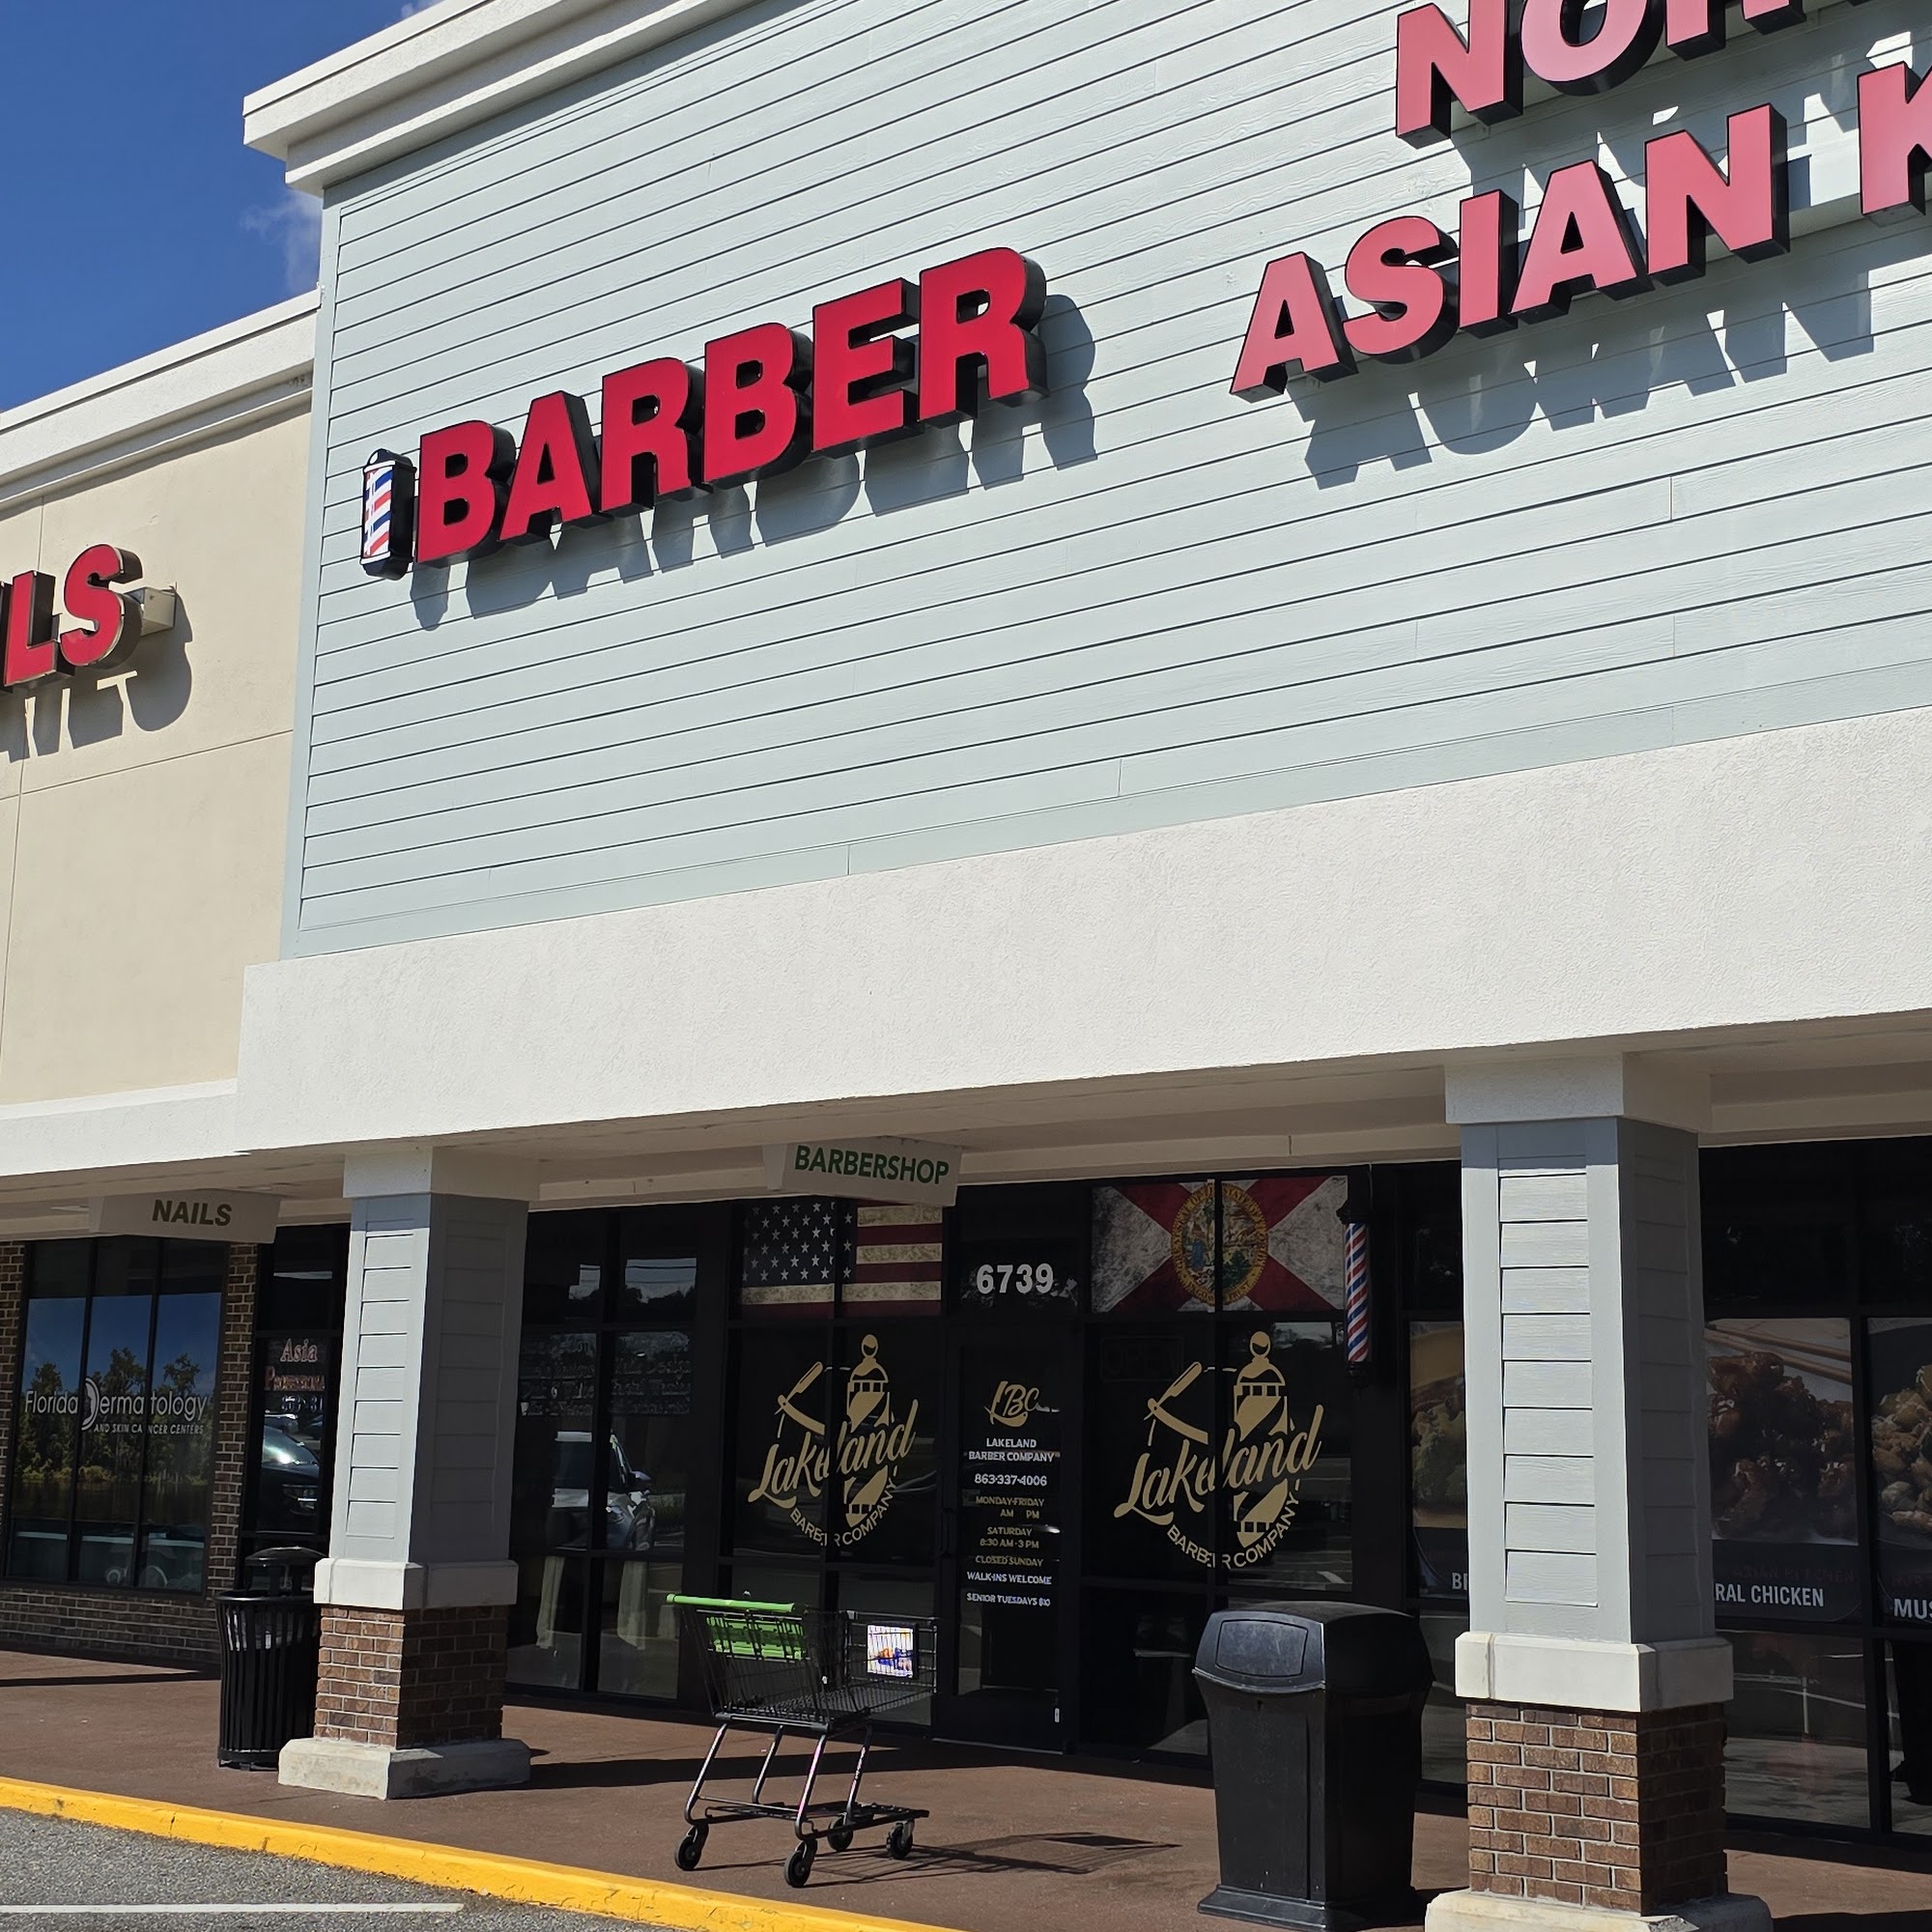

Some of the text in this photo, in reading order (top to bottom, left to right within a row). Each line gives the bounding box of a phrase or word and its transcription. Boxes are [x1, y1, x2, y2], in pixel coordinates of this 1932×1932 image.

[1229, 103, 1789, 398] ASIAN
[415, 247, 1047, 563] BARBER
[794, 1144, 950, 1185] BARBERSHOP
[152, 1199, 233, 1227] NAILS
[975, 1262, 1055, 1294] 6739
[279, 1338, 318, 1362] Asia
[24, 1391, 79, 1414] Florida
[94, 1423, 110, 1434] AND
[111, 1423, 129, 1434] SKIN
[169, 1425, 204, 1435] CENTERS
[748, 1399, 919, 1509] Lakeland
[985, 1437, 1037, 1449] LAKELAND
[968, 1451, 1055, 1463] BARBER COMPANY
[1114, 1404, 1324, 1525] Lakeland
[841, 1477, 897, 1547] COMPANY
[1000, 1509, 1040, 1520] AM PM
[986, 1526, 1033, 1537] SATURDAY
[1233, 1491, 1299, 1568] COMPANY
[980, 1538, 999, 1547] 8:30
[999, 1539, 1014, 1548] AM
[1017, 1540, 1024, 1548] 3
[1025, 1540, 1039, 1549] PM
[975, 1555, 1044, 1568] CLOSED SUNDAY
[1009, 1574, 1053, 1585] WELCOME
[966, 1592, 996, 1604] SENIOR
[997, 1595, 1037, 1606] TUESDAYS
[1750, 1585, 1825, 1607] CHICKEN
